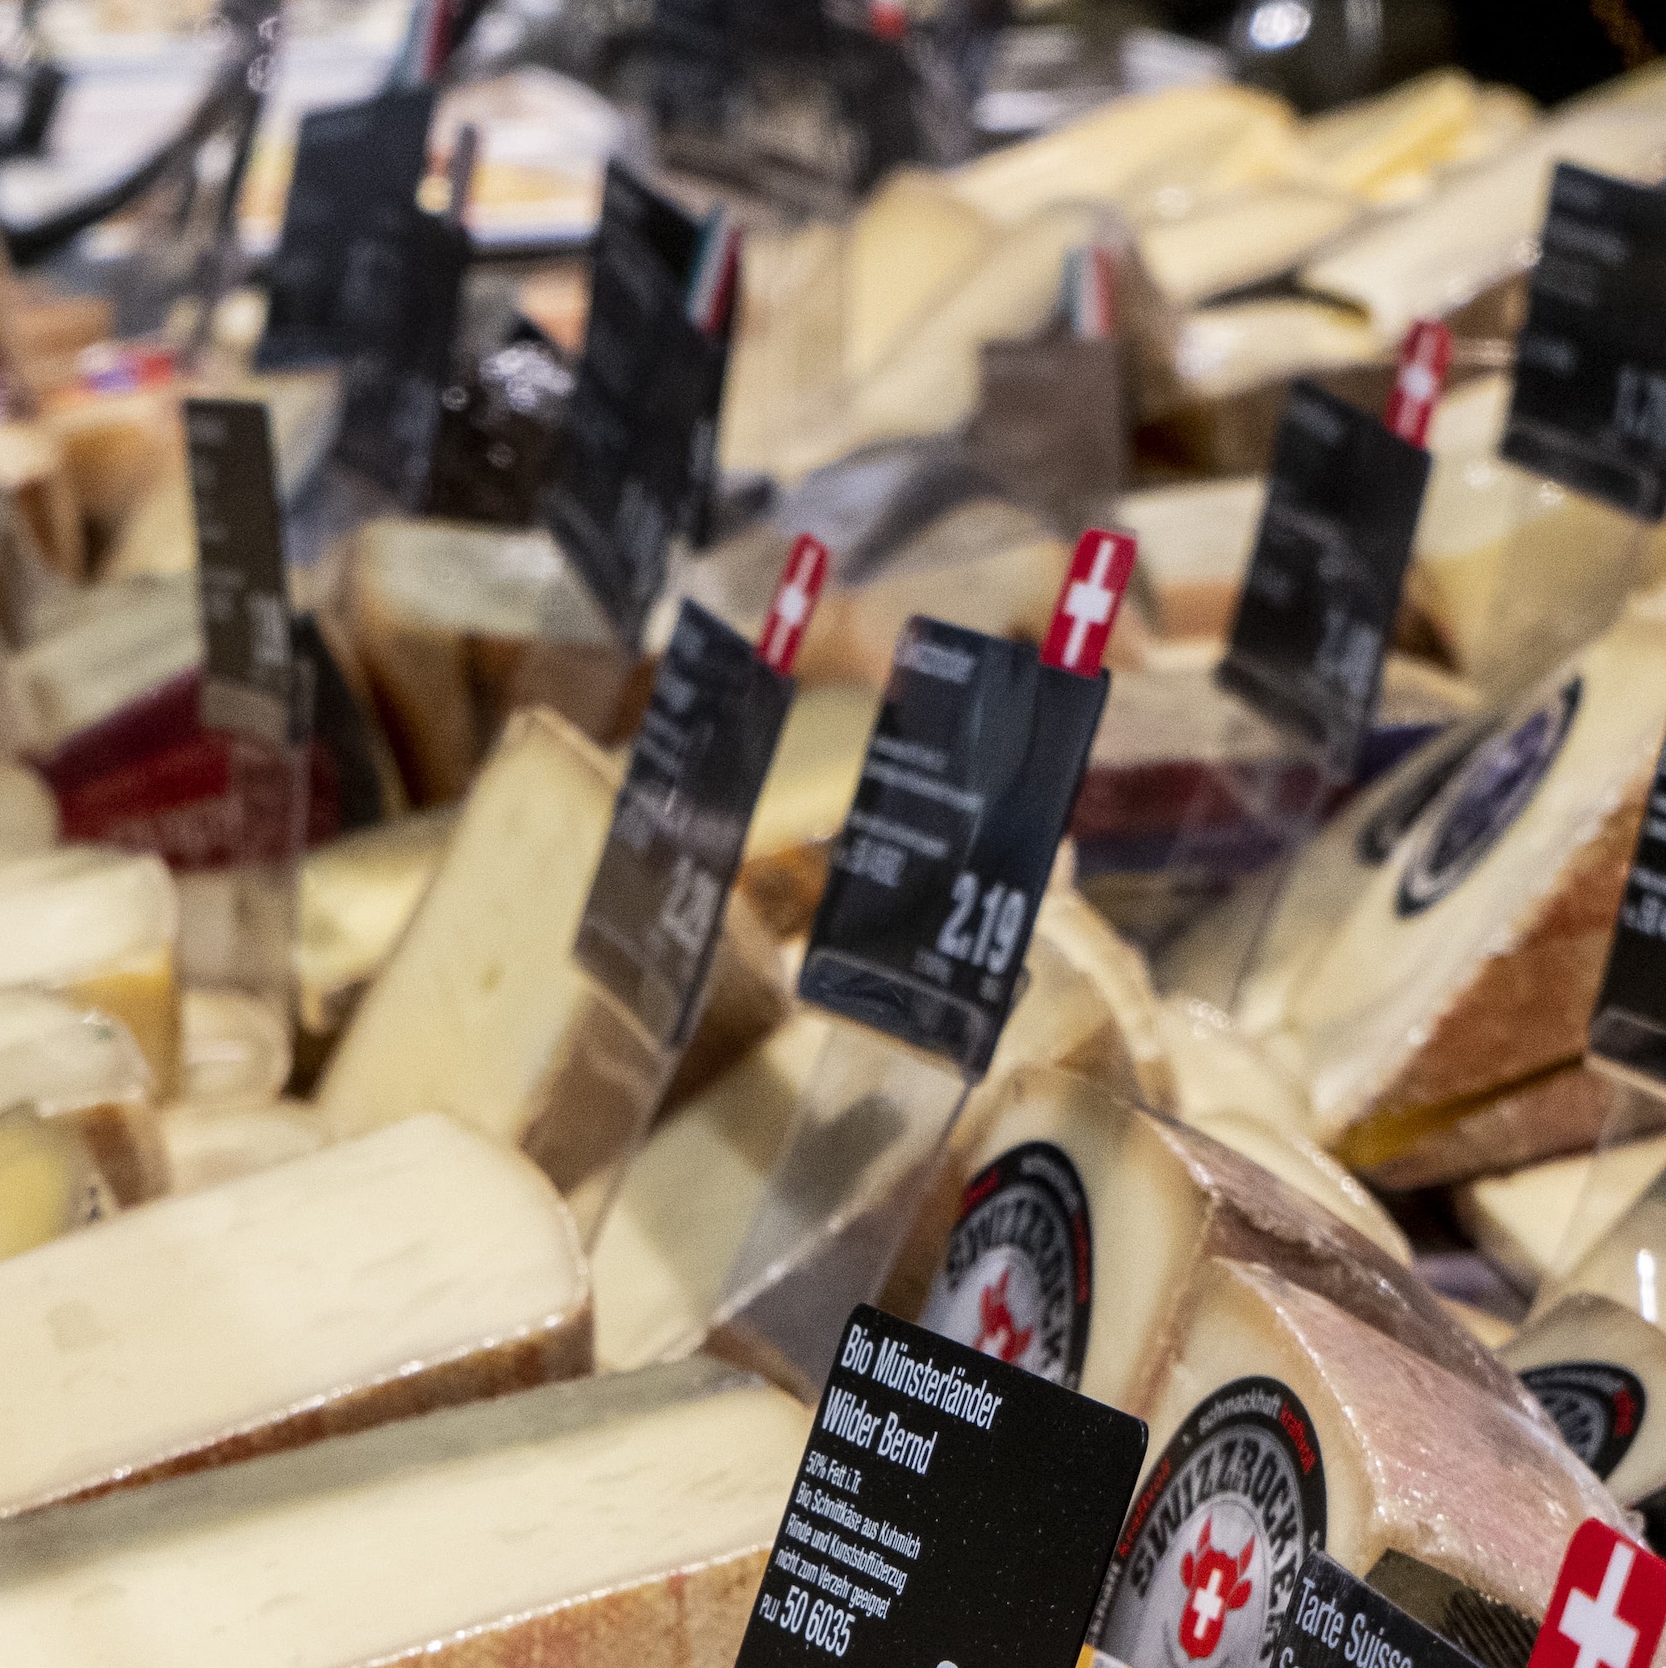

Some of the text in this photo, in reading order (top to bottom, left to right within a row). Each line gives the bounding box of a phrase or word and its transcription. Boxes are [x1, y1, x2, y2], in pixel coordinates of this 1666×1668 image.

[938, 874, 1025, 973] 2.19
[841, 1324, 1002, 1429] Bio Münsterländer
[822, 1386, 938, 1474] Wilder Bernd
[806, 1451, 862, 1494] 50% Fett i.Tr.
[786, 1513, 907, 1595] Rinde und Kunststoffüberzug
[795, 1481, 921, 1559] Bio Schnittkäse aus Kuhmilch
[759, 1585, 855, 1656] PLU 50 6035
[775, 1549, 891, 1619] nicht zum Verzehr geeignet
[1295, 1577, 1344, 1649] Tarte
